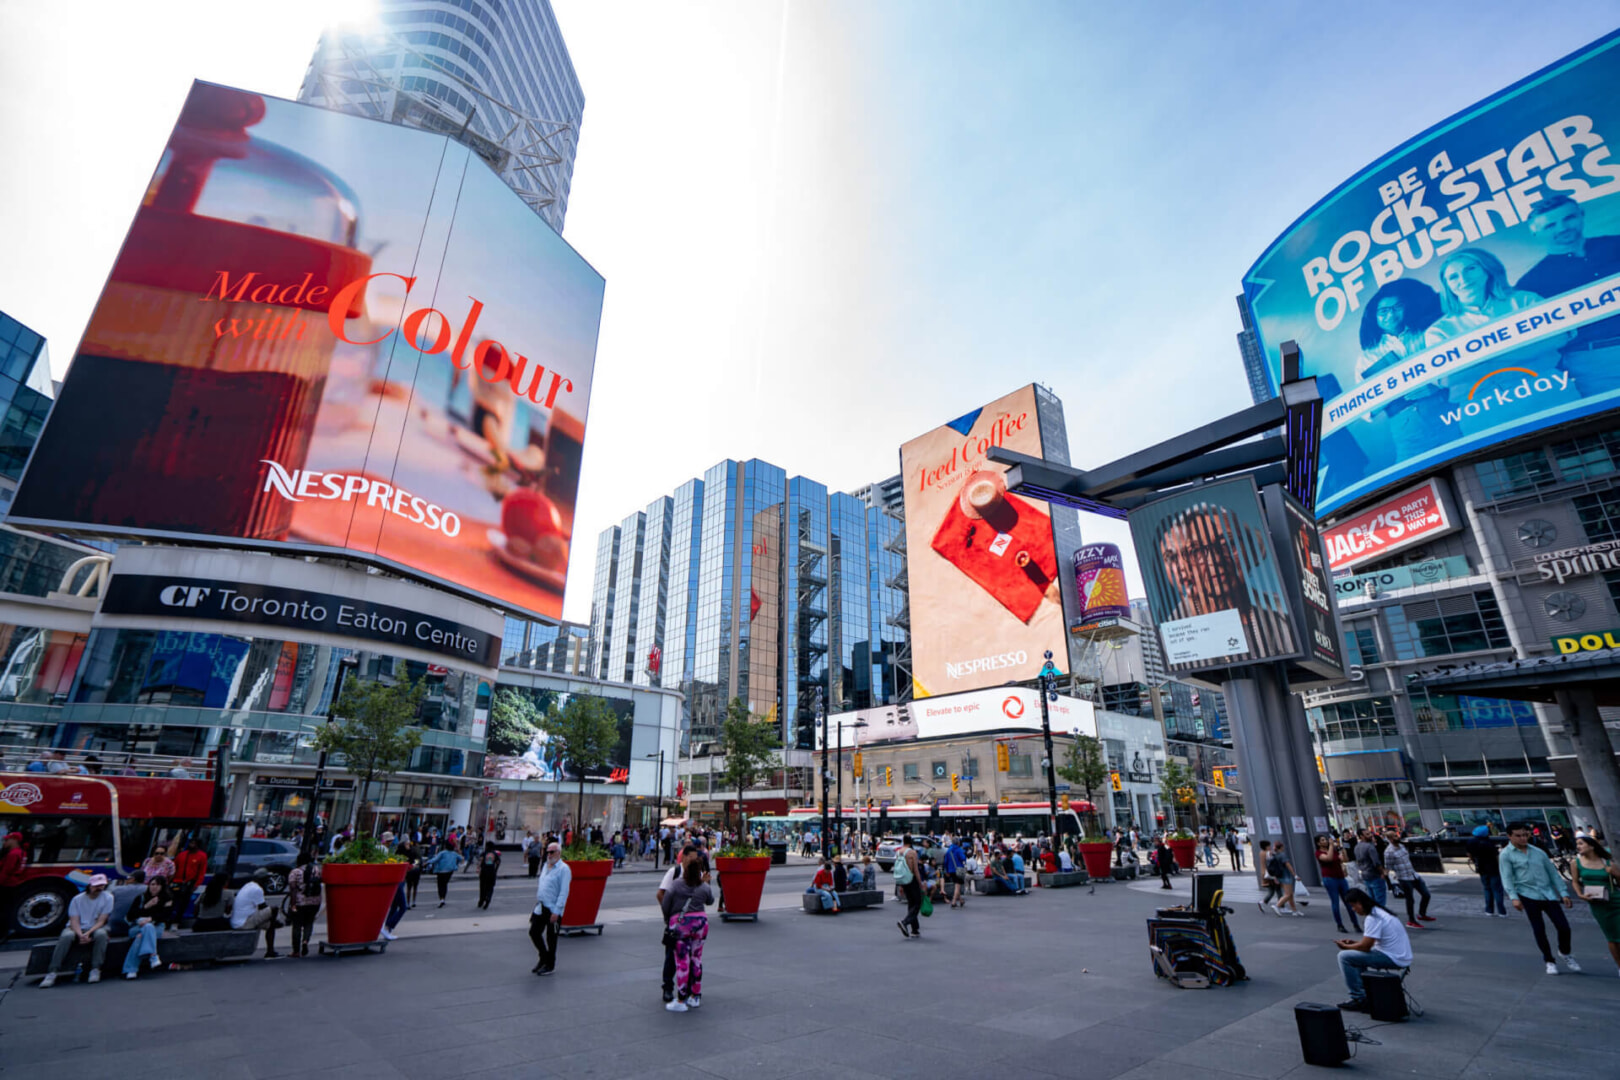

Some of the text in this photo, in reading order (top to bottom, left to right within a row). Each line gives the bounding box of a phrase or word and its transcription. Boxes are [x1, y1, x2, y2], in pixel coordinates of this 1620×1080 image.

[1378, 150, 1453, 206] BE A
[1302, 114, 1604, 298] ROCK STAR
[1314, 145, 1620, 331] OF BUSINESS
[200, 270, 329, 306] Made
[214, 307, 308, 341] with
[327, 272, 573, 410] Colour
[1329, 384, 1384, 422] FINANCE
[1386, 377, 1398, 389] &
[1402, 363, 1427, 383] HR
[1430, 347, 1461, 368] ON
[1465, 327, 1512, 353] ONE
[1515, 307, 1565, 334] EPIC
[1439, 371, 1570, 426] workday
[920, 413, 1027, 492] Iced Coffee
[259, 459, 461, 537] NESPRESSO
[1401, 496, 1429, 514] PARTY
[1403, 508, 1426, 523] THIS
[1326, 509, 1405, 565] JACK'S
[1406, 517, 1427, 531] WAY
[1534, 548, 1580, 562] LOUNGE
[159, 585, 477, 653] CF Toronto Eaton Centre
[946, 650, 1028, 679] NESPRESSO
[1557, 633, 1620, 654] DOL
[926, 702, 980, 717] Elevate to epic
[270, 777, 299, 785] Dundas
